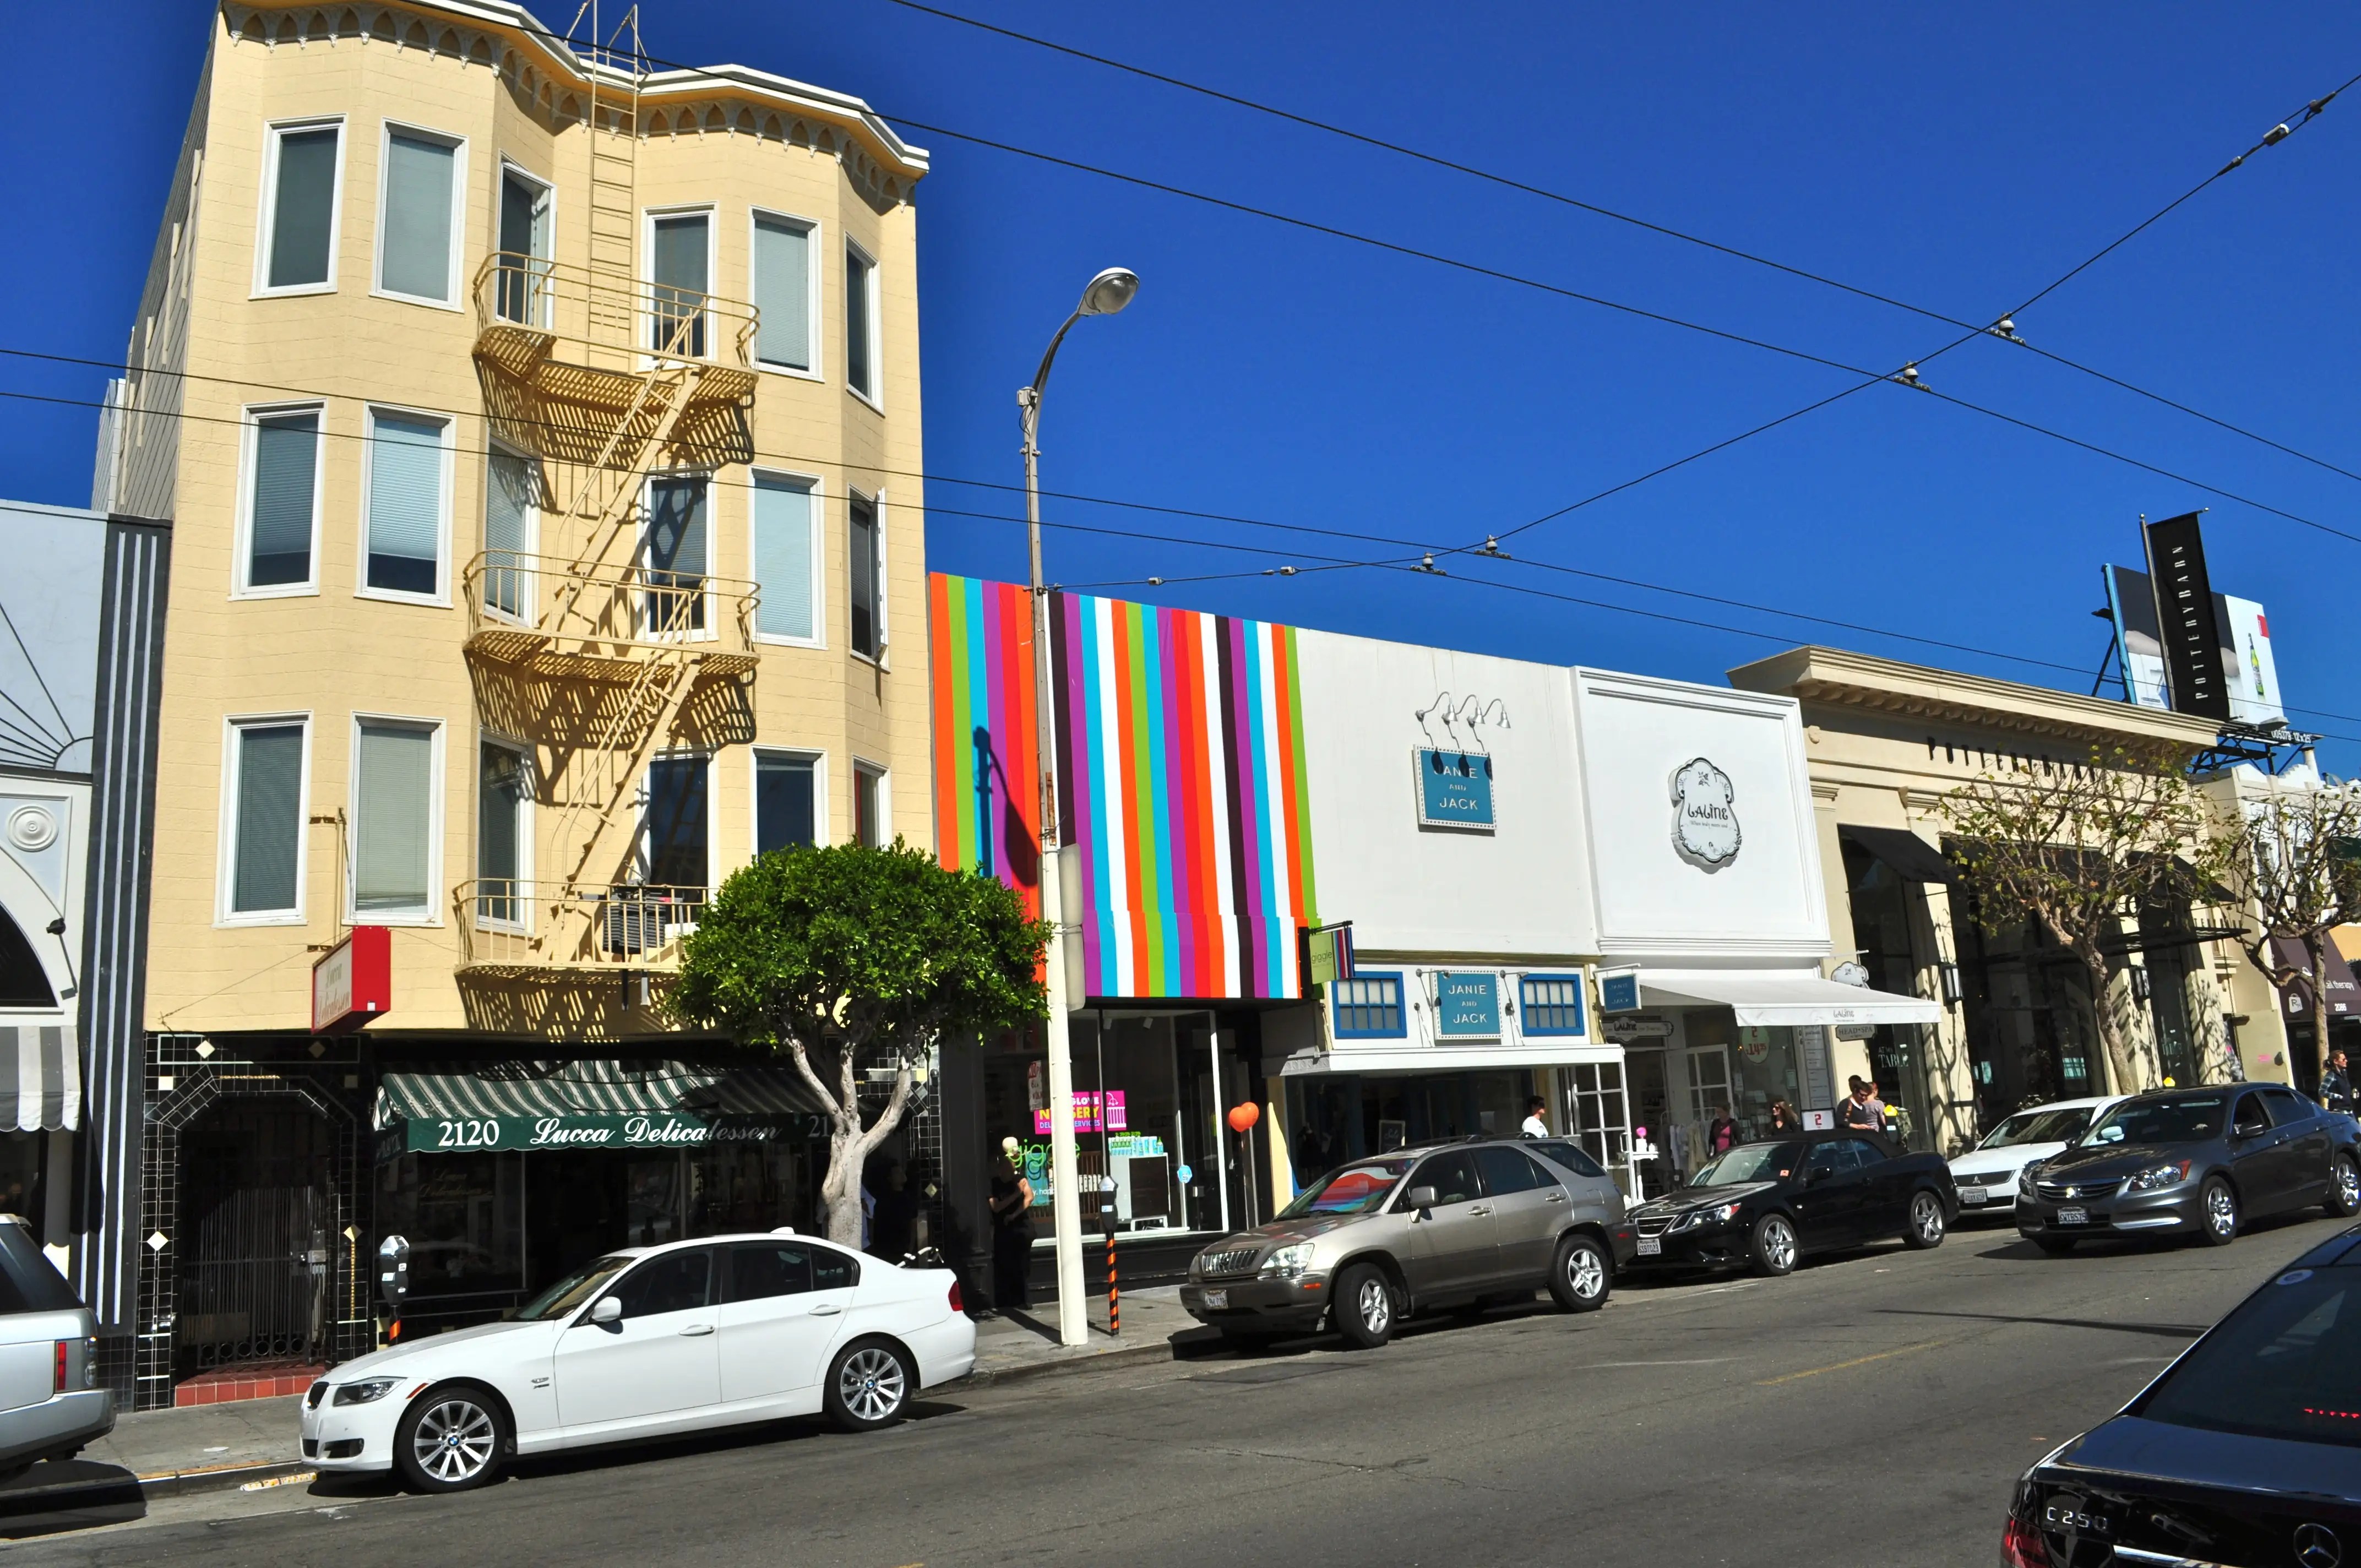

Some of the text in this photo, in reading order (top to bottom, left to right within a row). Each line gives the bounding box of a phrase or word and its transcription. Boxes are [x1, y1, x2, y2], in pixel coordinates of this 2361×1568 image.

[1434, 765, 1478, 778] ANE
[1439, 797, 1478, 810] JACK
[1311, 949, 1332, 964] giggle
[1448, 984, 1487, 994] JANIE
[1453, 1014, 1487, 1023] JACK
[1039, 1106, 1100, 1120] NSERY
[1074, 1119, 1101, 1128] ERVICES
[438, 1115, 830, 1146] 2120 Lucca Delicatessen 21
